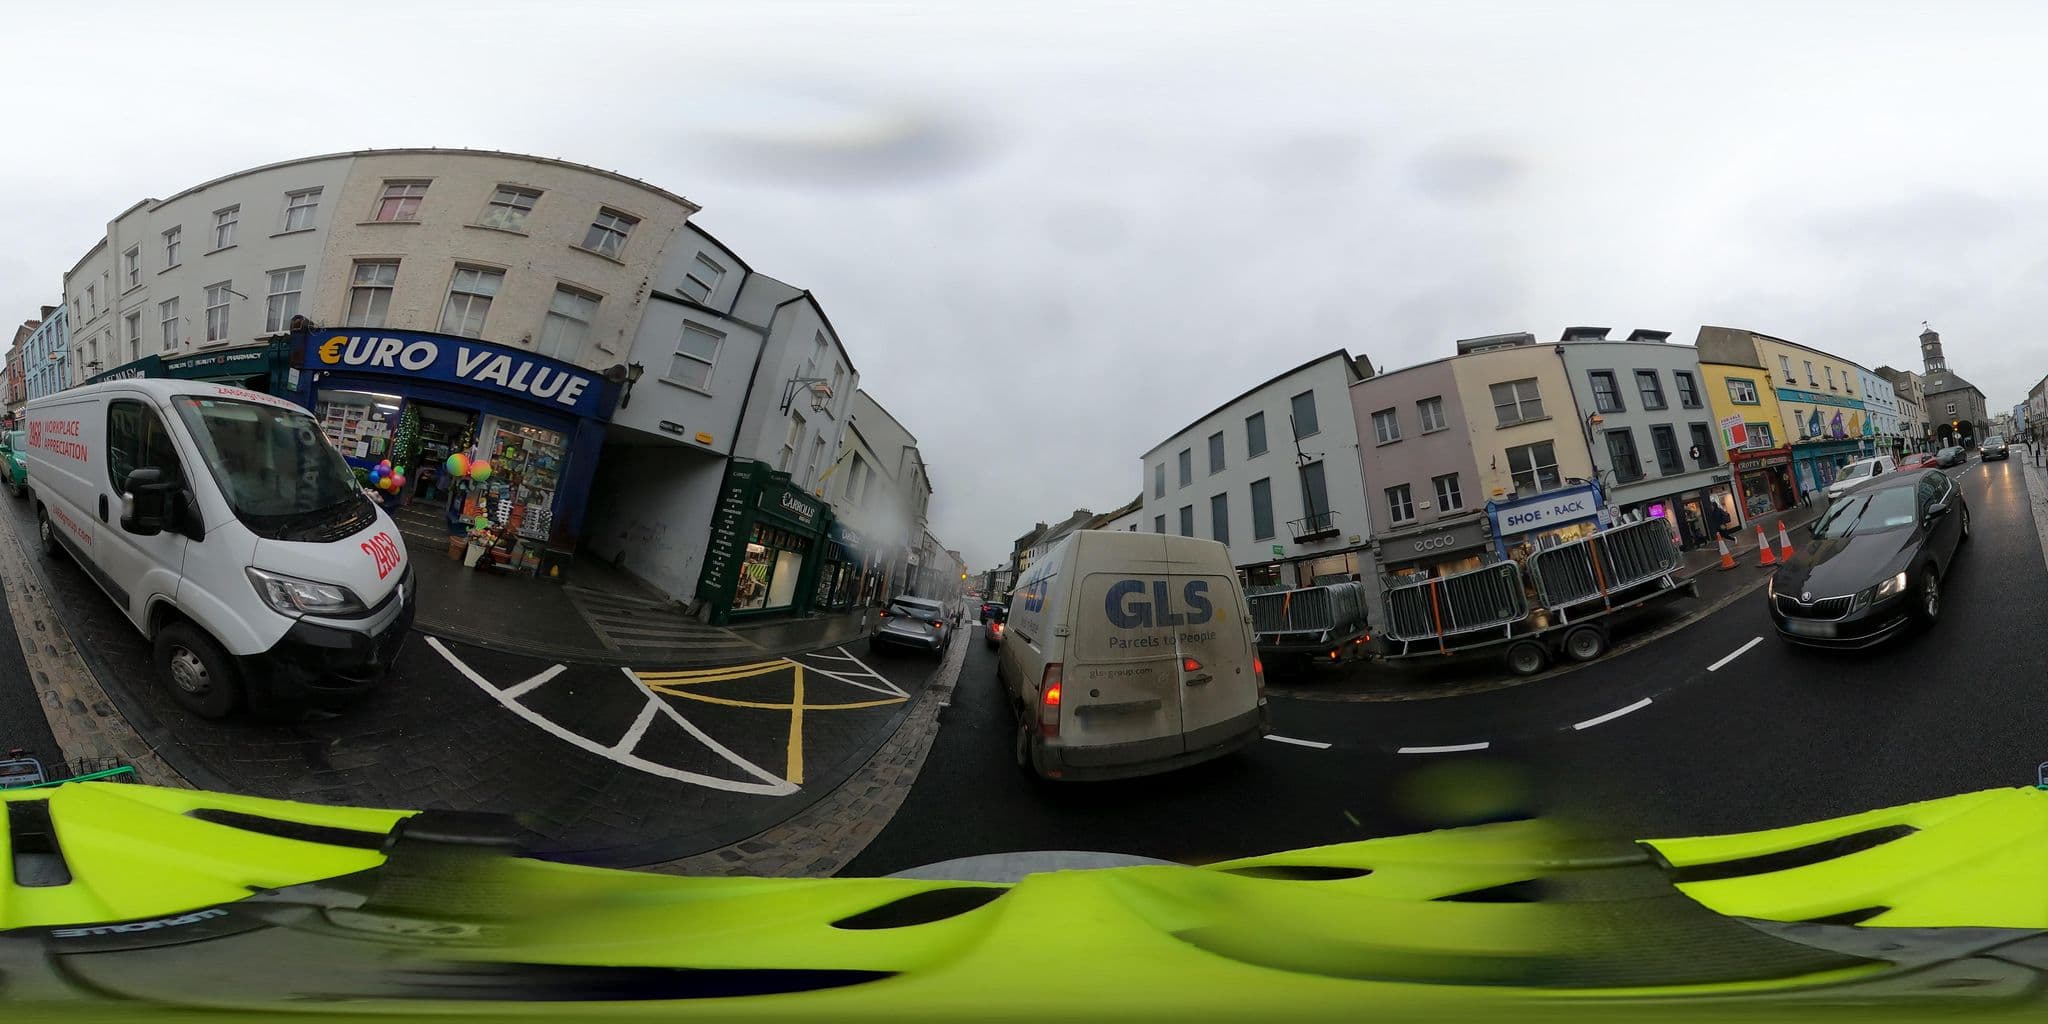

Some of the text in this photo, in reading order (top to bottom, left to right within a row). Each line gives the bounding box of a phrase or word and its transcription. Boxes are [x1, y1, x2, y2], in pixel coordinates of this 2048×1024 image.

[226, 352, 262, 361] PHARMACY
[455, 346, 590, 406] VALUE
[44, 420, 80, 436] WORKPLACE
[44, 438, 88, 462] APPRECIATION
[1507, 500, 1585, 526] SHOE RACK
[1414, 534, 1455, 551] ecco
[360, 532, 400, 580] 2468
[1105, 579, 1213, 629] GLS
[1109, 630, 1216, 649] Parcels to People
[1089, 667, 1153, 680] gls-group.com
